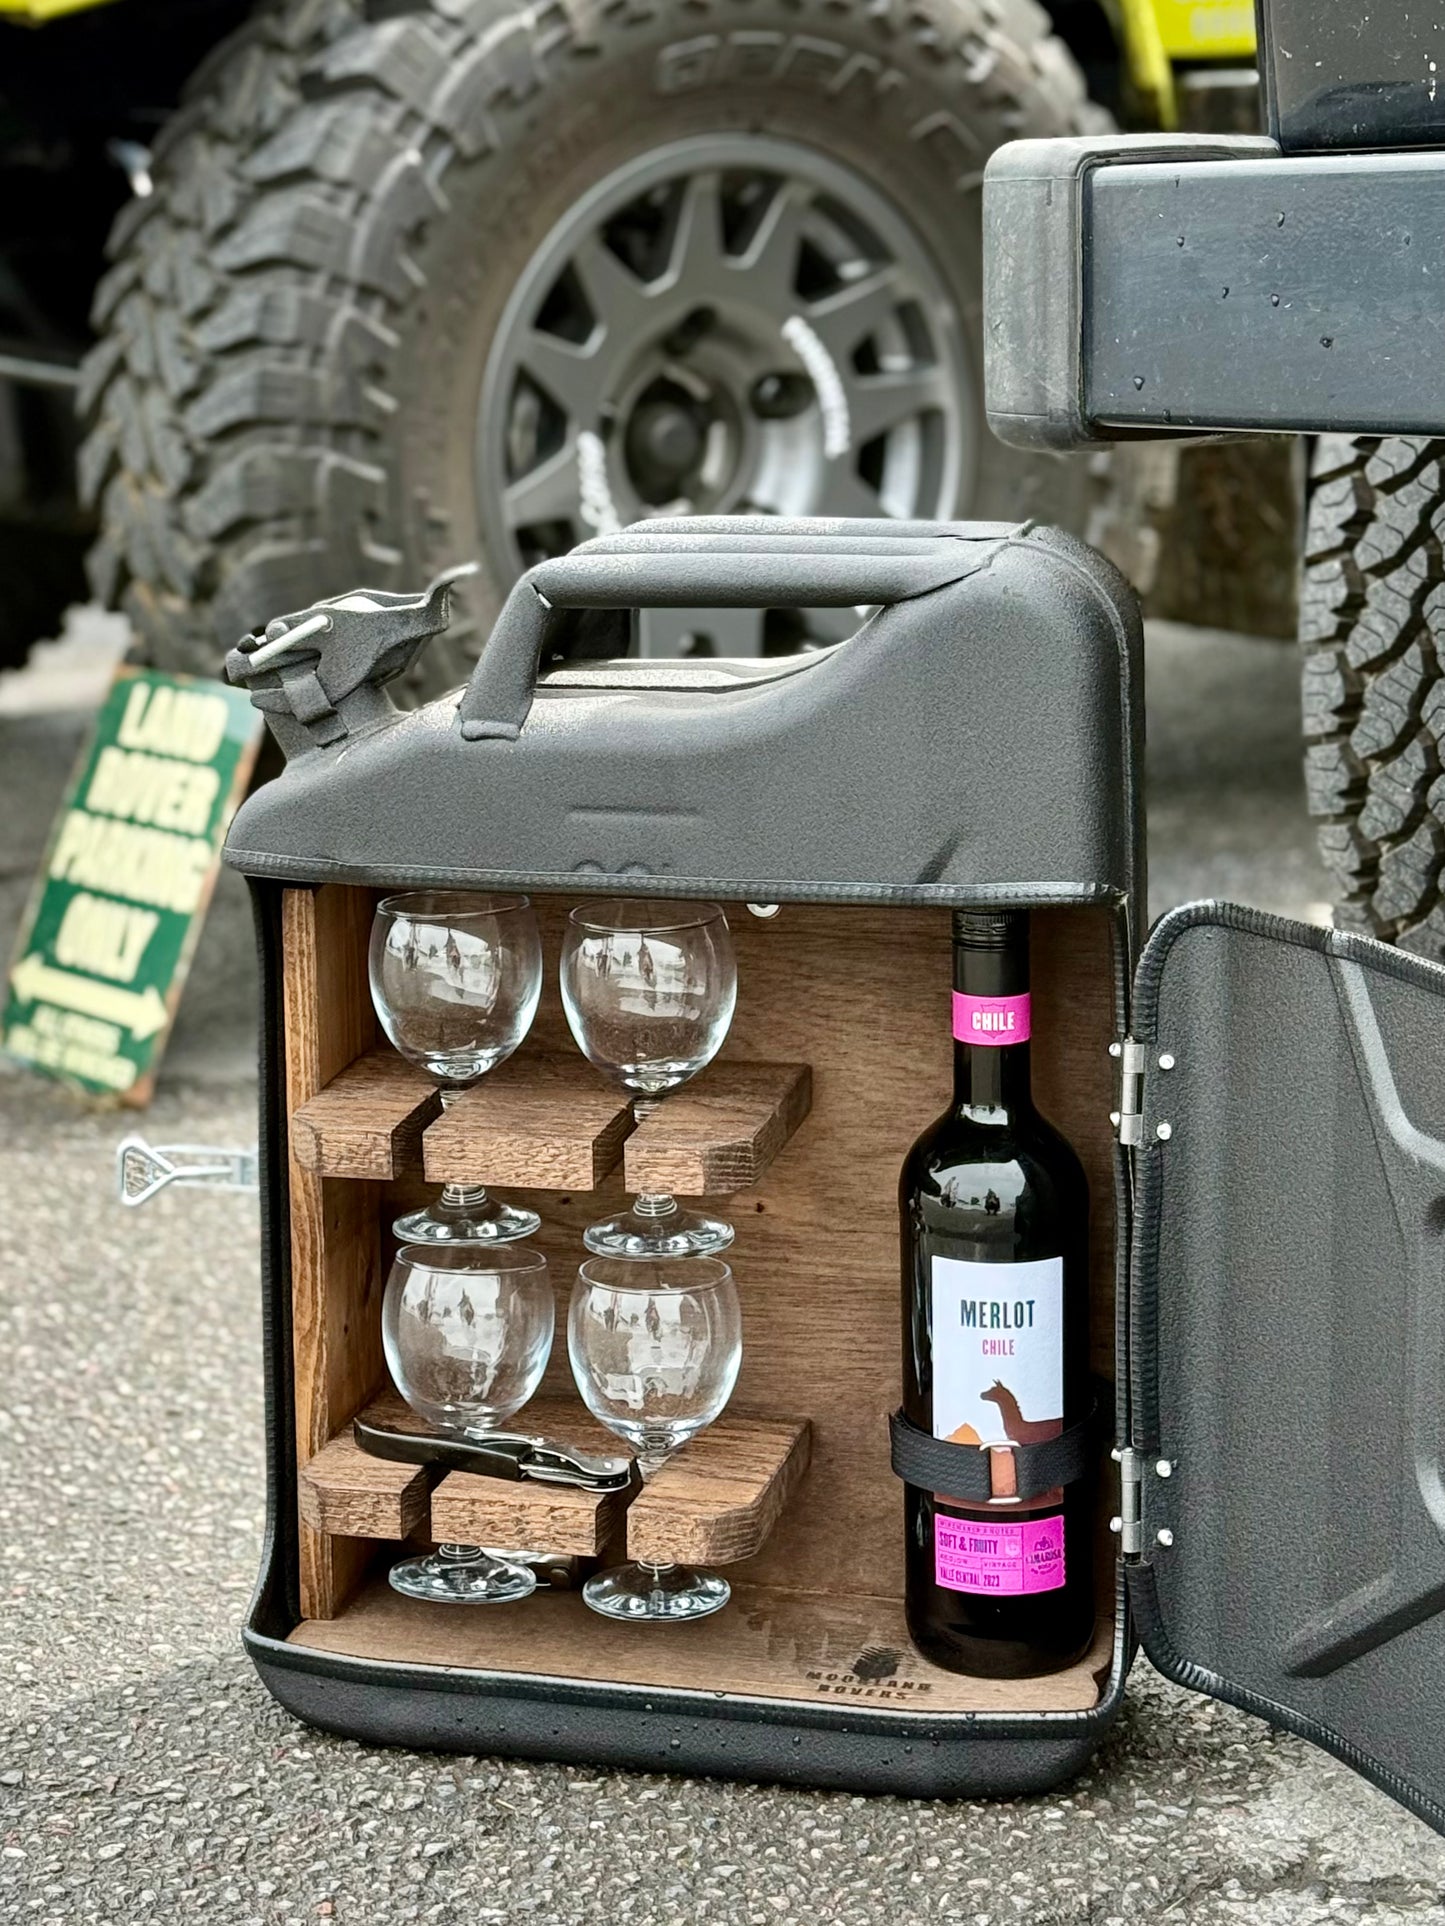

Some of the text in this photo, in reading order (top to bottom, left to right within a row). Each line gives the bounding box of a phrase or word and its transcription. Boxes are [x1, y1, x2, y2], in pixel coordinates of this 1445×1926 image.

[118, 681, 229, 762] LAND
[86, 745, 221, 834] ROVER
[56, 892, 160, 983] ONLY
[971, 1011, 1015, 1031] CHILE
[960, 1299, 1035, 1329] MERLOT
[982, 1339, 1015, 1356] CHILE
[939, 1531, 998, 1555] SOFT & FRUITY
[984, 1561, 1017, 1569] VINTAGE
[817, 1684, 907, 1700] ROVERS
